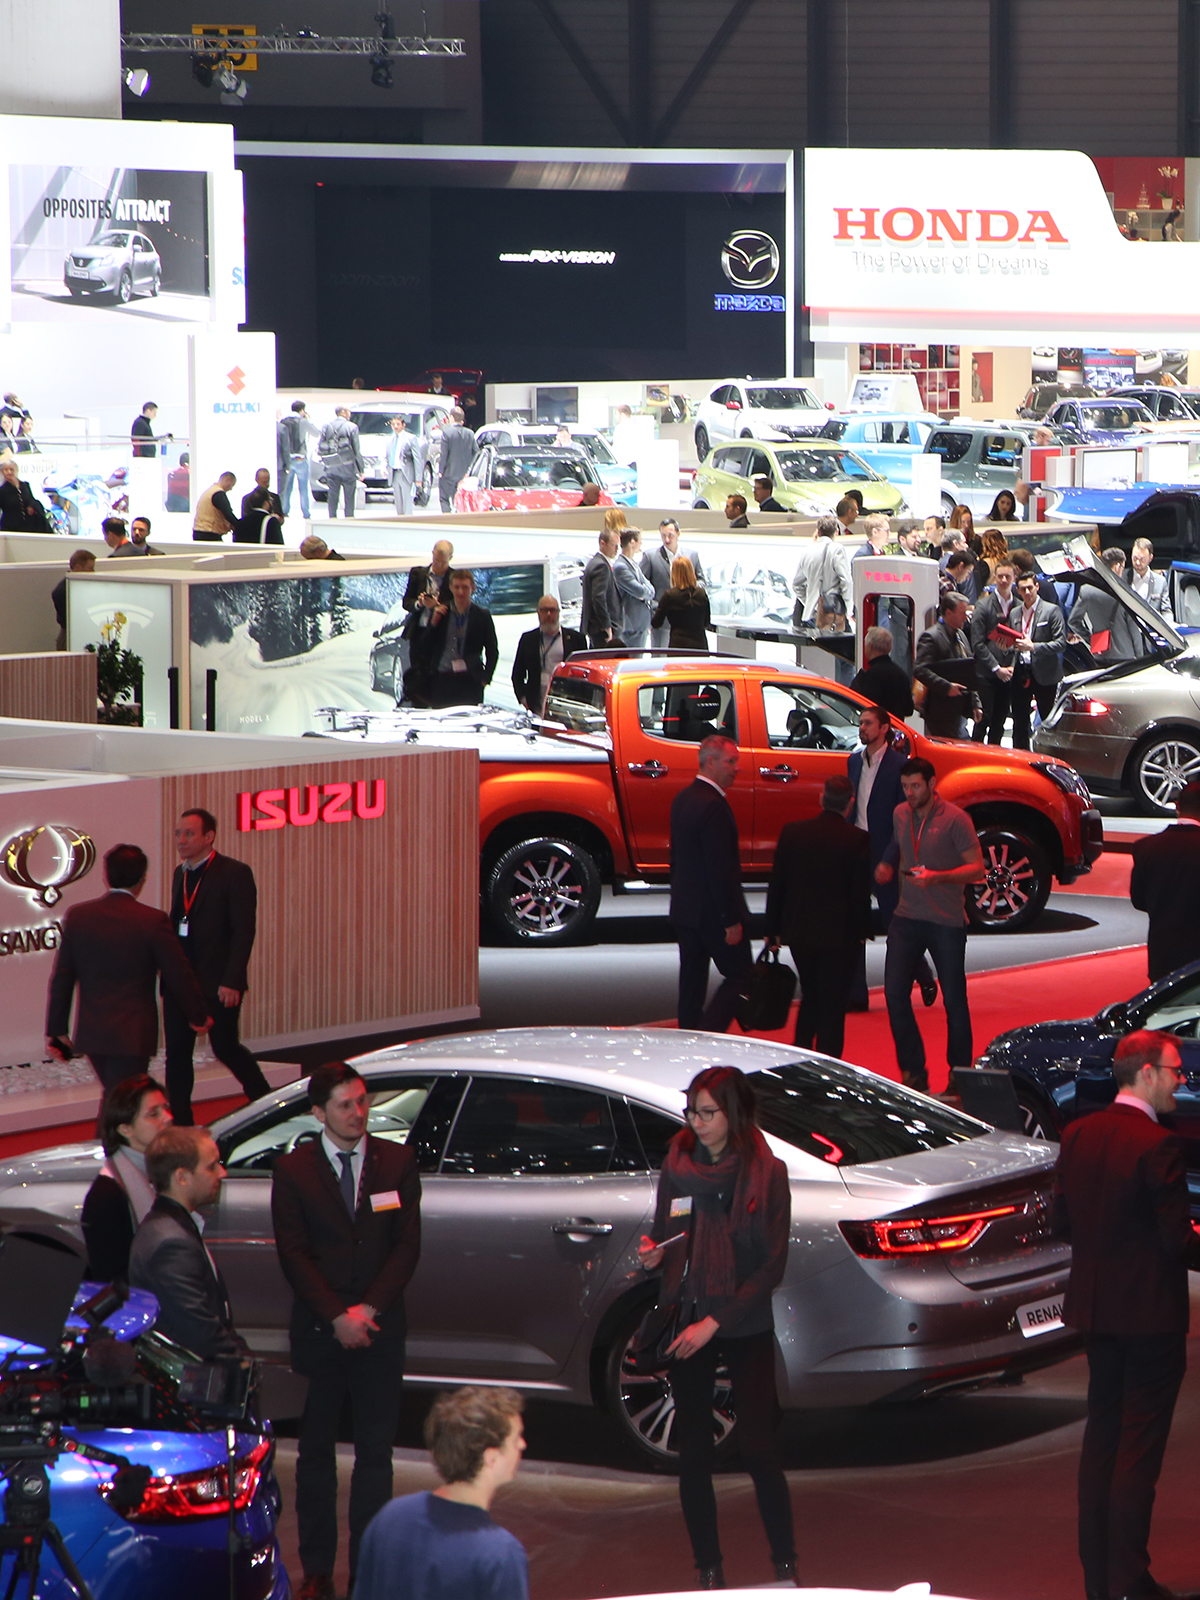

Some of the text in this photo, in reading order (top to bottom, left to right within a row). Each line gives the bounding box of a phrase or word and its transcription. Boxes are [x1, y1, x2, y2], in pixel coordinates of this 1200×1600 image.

[43, 197, 172, 221] OPPOSITES ATTRACT
[833, 207, 1069, 243] HONDA
[852, 251, 1049, 271] The Power of Dreams
[213, 402, 260, 414] SUZUKI
[864, 571, 913, 583] TESLA
[239, 715, 263, 724] MODEL
[237, 779, 386, 832] ISUZU
